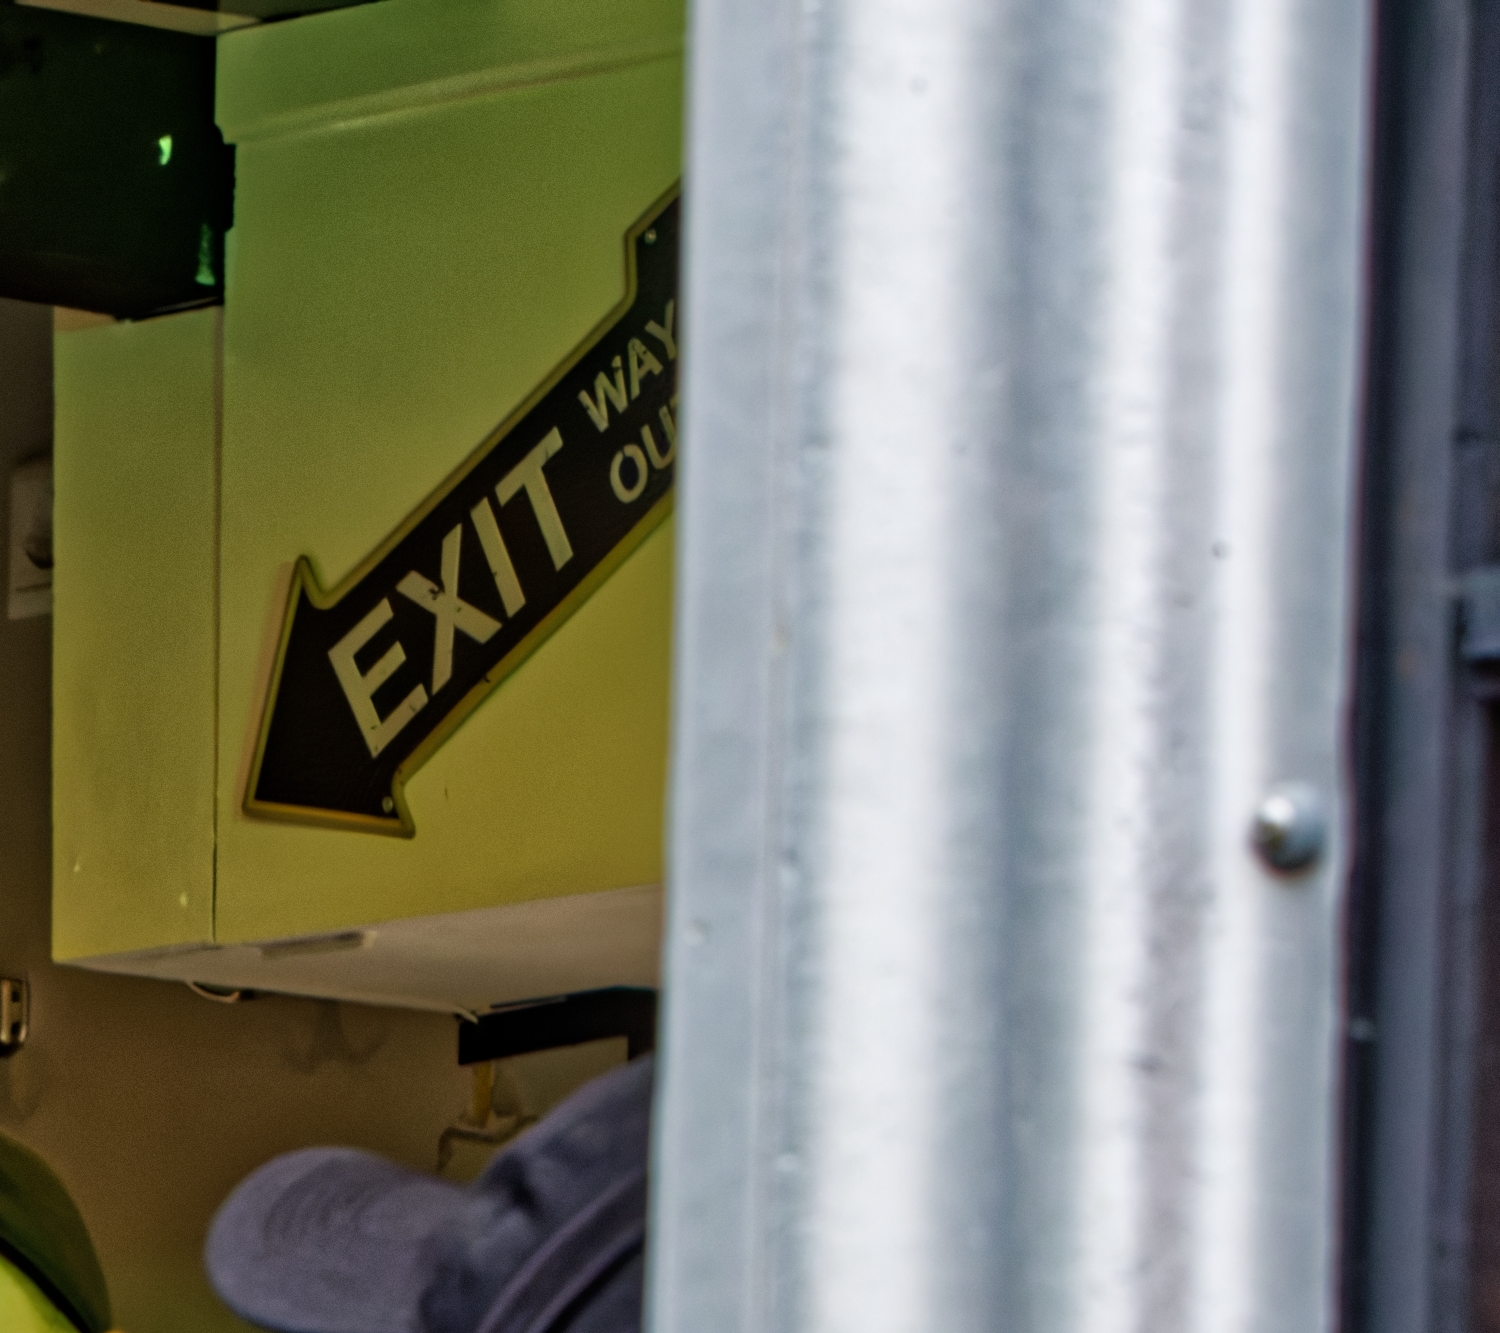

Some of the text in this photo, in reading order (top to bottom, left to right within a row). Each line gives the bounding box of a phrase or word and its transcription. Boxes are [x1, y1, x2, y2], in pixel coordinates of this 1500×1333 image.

[579, 300, 678, 431] WAY
[609, 395, 677, 503] OU
[328, 427, 573, 758] EXIT
